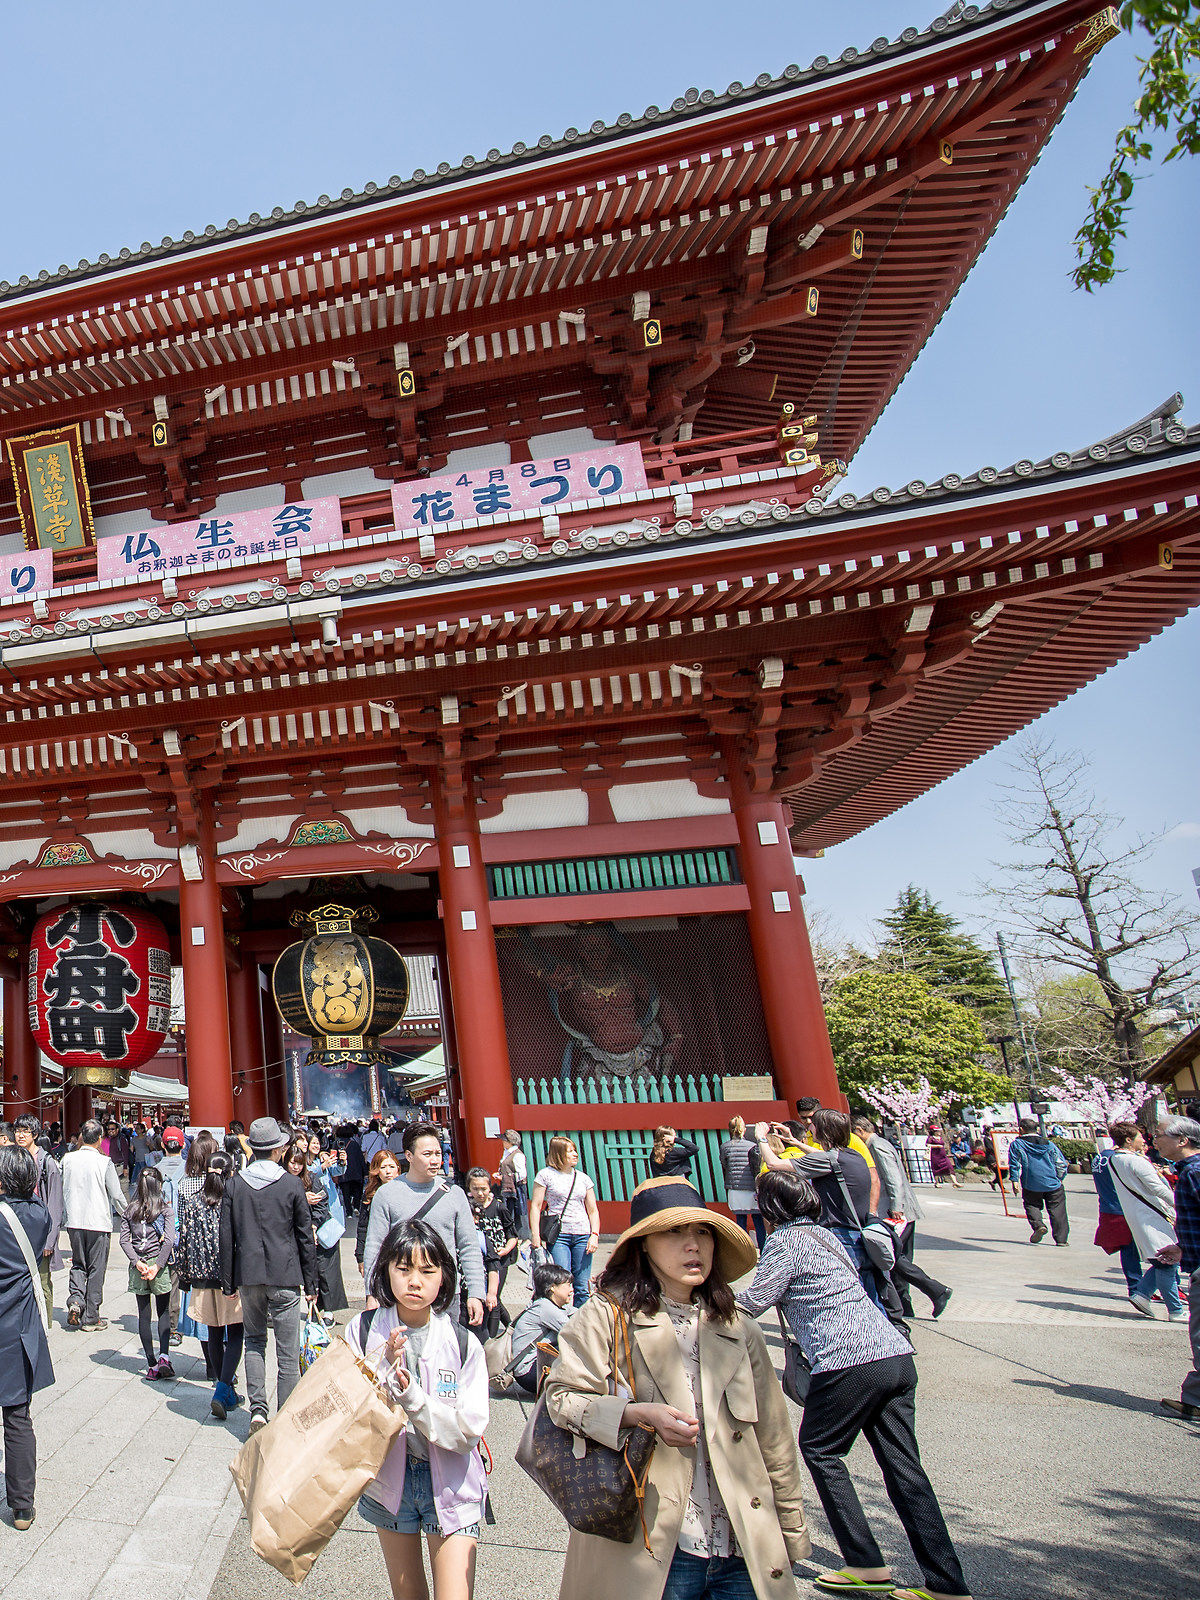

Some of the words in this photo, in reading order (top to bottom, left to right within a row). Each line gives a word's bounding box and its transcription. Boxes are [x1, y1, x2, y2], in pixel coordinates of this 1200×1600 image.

[412, 464, 623, 525] 花まつり
[455, 458, 572, 487] 4月8日
[120, 505, 314, 564] 仏生会
[137, 535, 299, 573] お釈迦さまのお誕生日
[44, 904, 141, 1060] 小舟町
